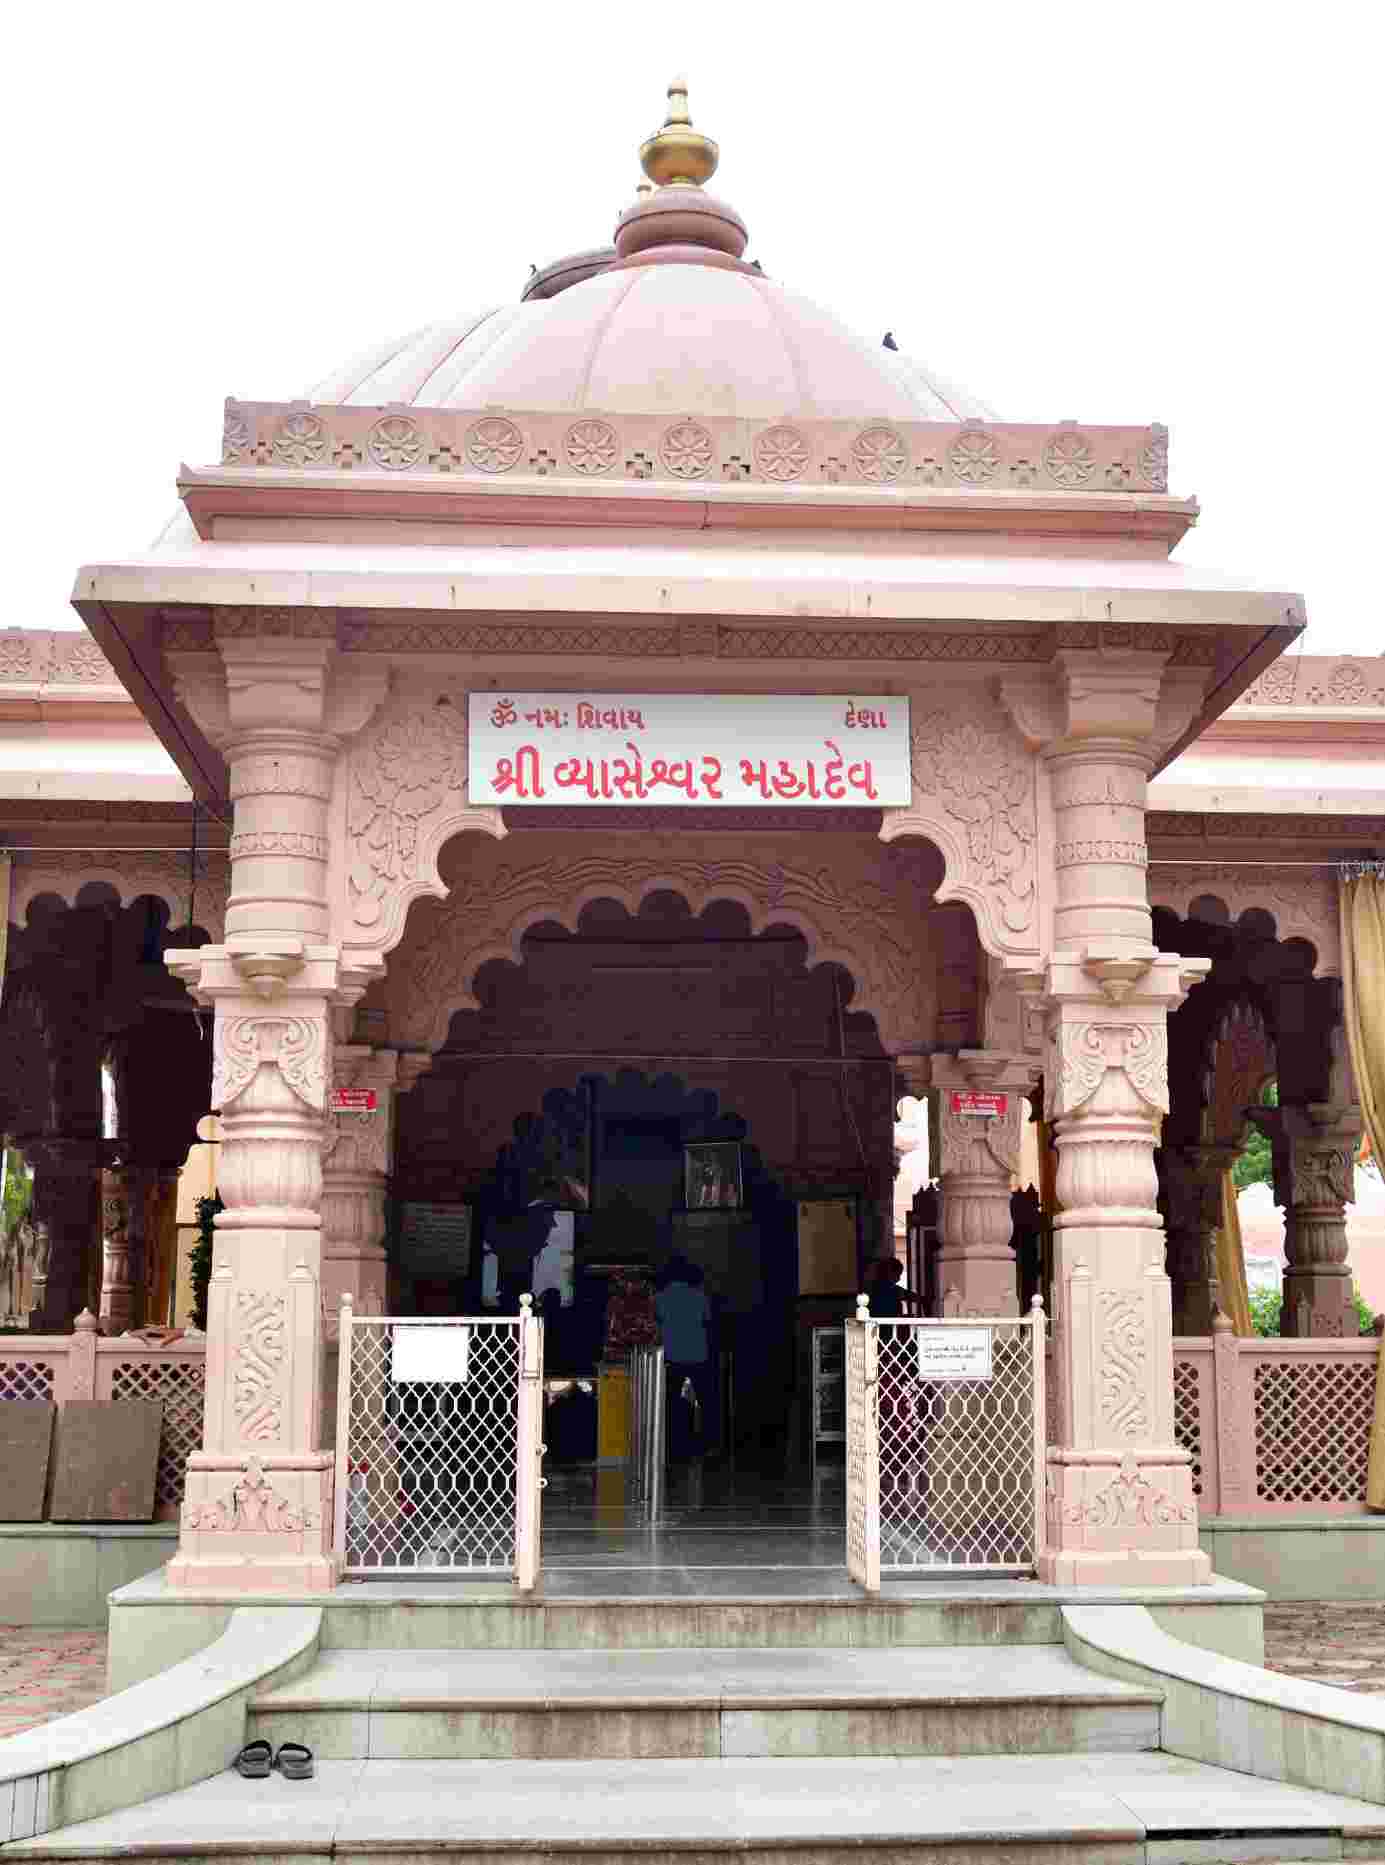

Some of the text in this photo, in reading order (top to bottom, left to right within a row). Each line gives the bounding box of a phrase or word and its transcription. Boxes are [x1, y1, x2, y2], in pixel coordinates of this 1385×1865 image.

[575, 701, 646, 731] શિવાય
[845, 699, 889, 729] દેણા
[490, 740, 878, 801] શ્રી વ્યાસેશ્વર મહાદેવ
